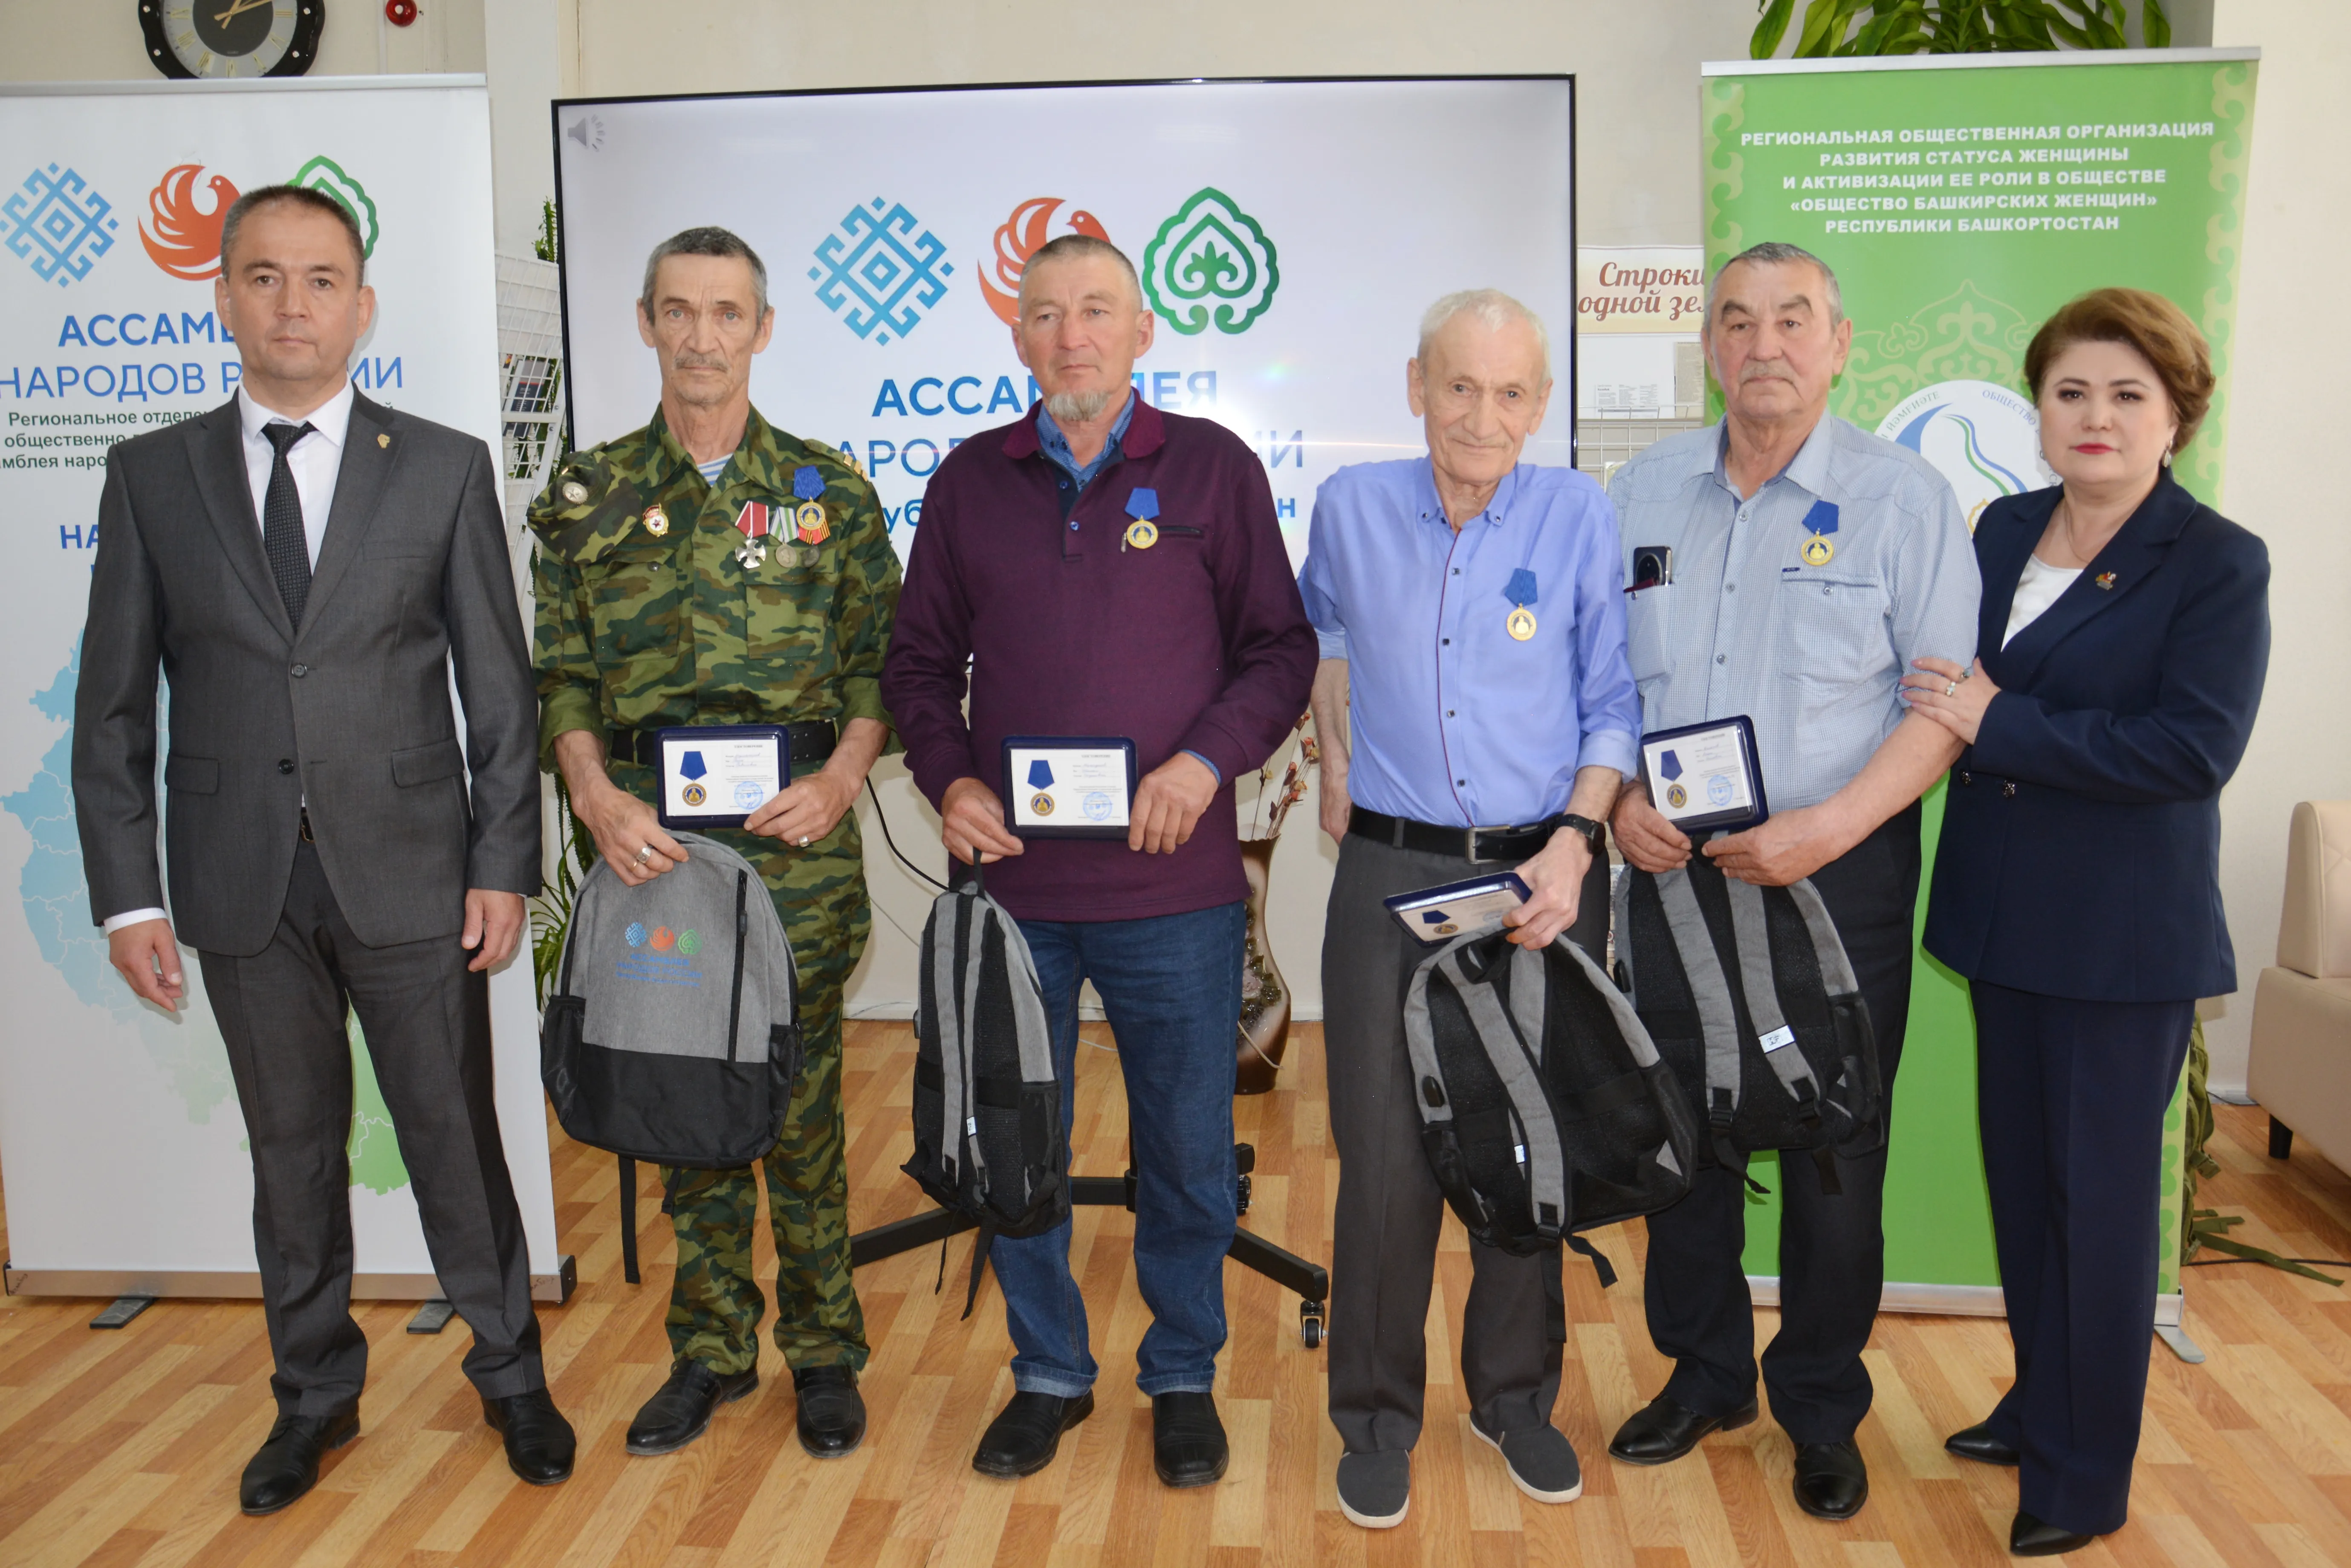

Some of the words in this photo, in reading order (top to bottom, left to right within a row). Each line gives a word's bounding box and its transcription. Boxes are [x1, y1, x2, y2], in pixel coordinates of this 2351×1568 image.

[1742, 130, 1893, 145] РЕГИОНАЛЬНАЯ
[1900, 126, 2061, 144] ОБЩЕСТВЕННАЯ
[2067, 122, 2214, 138] ОРГАНИЗАЦИЯ
[1820, 152, 1920, 166] РАЗВИТИЯ
[1926, 150, 2013, 164] СТАТУСА
[2019, 148, 2128, 163] ЖЕНЩИНЫ
[1784, 176, 1796, 189] И
[1802, 174, 1943, 190] АКТИВИЗАЦИИ
[1950, 173, 1973, 186] ЕЕ
[1980, 172, 2032, 186] РОЛИ
[2039, 172, 2050, 185] В
[2057, 169, 2166, 186] ОБЩЕСТВЕ
[1791, 197, 1908, 213] «ОБЩЕСТВО
[1914, 194, 2048, 210] БАШКИРСКИХ
[2055, 193, 2157, 208] ЖЕНЩИН»
[1826, 219, 1952, 233] РЕСПУБЛИКИ
[1958, 217, 2119, 231] БАШКОРТОСТАН
[1578, 289, 1661, 321] одной
[58, 312, 234, 347] АССАМ
[0, 363, 206, 402] НАРОДОВ
[872, 370, 1217, 417] АССАЕЯ
[1982, 390, 2036, 425] ОБЩЕСТВО
[9, 412, 137, 426] Региональное
[143, 411, 208, 425] отдел
[5, 433, 141, 449] общественно
[0, 454, 58, 469] мблея
[65, 455, 107, 471] наро
